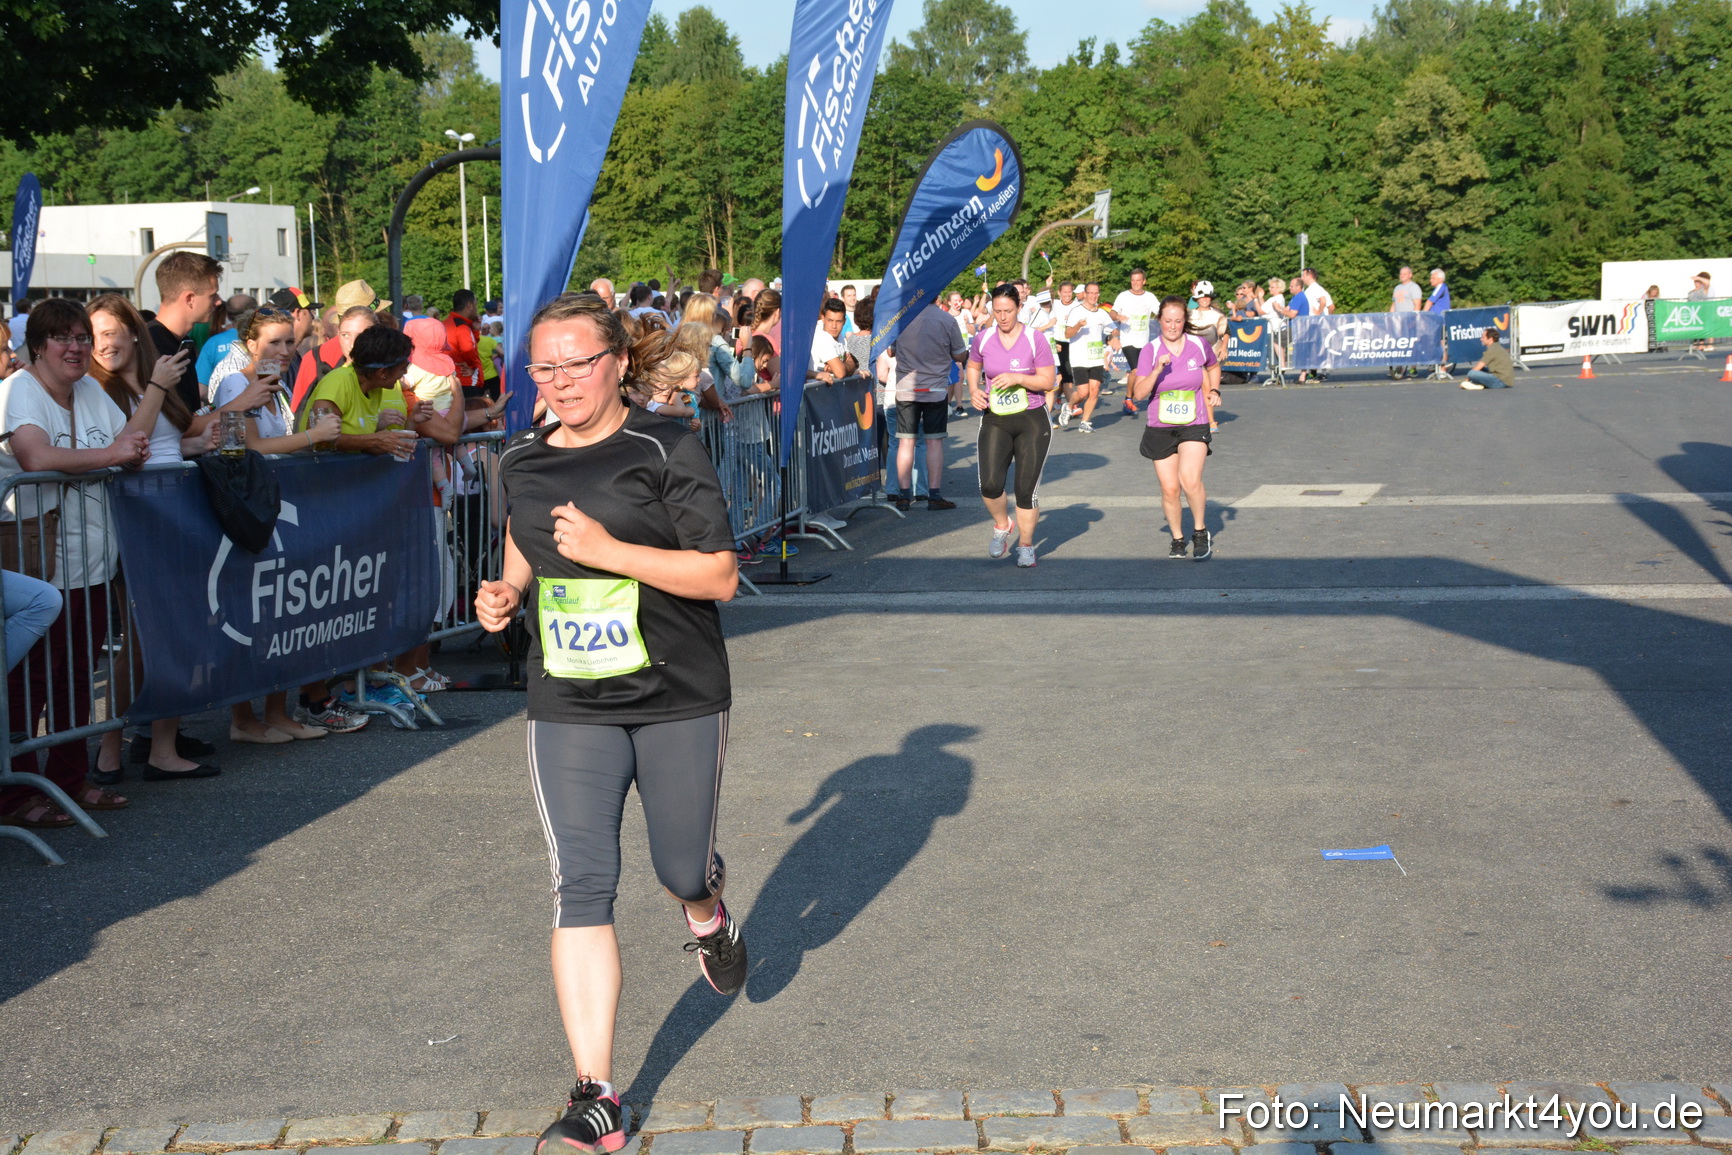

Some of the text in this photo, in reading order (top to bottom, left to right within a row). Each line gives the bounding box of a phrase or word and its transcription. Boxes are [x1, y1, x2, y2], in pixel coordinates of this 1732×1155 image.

[950, 184, 1016, 250] Druck und Medien
[892, 195, 984, 288] Frischmann
[1663, 305, 1704, 327] AOK
[1342, 334, 1418, 352] Fischer
[1450, 323, 1498, 341] Frischm
[1238, 350, 1262, 358] Medien
[1349, 349, 1413, 360] AUTOMOBILE
[997, 393, 1020, 406] 468
[1166, 403, 1189, 415] 469
[811, 419, 859, 457] Frischmann
[252, 544, 387, 623] Fischer
[266, 607, 377, 660] AUTOMOBILE
[549, 618, 629, 652] 1220
